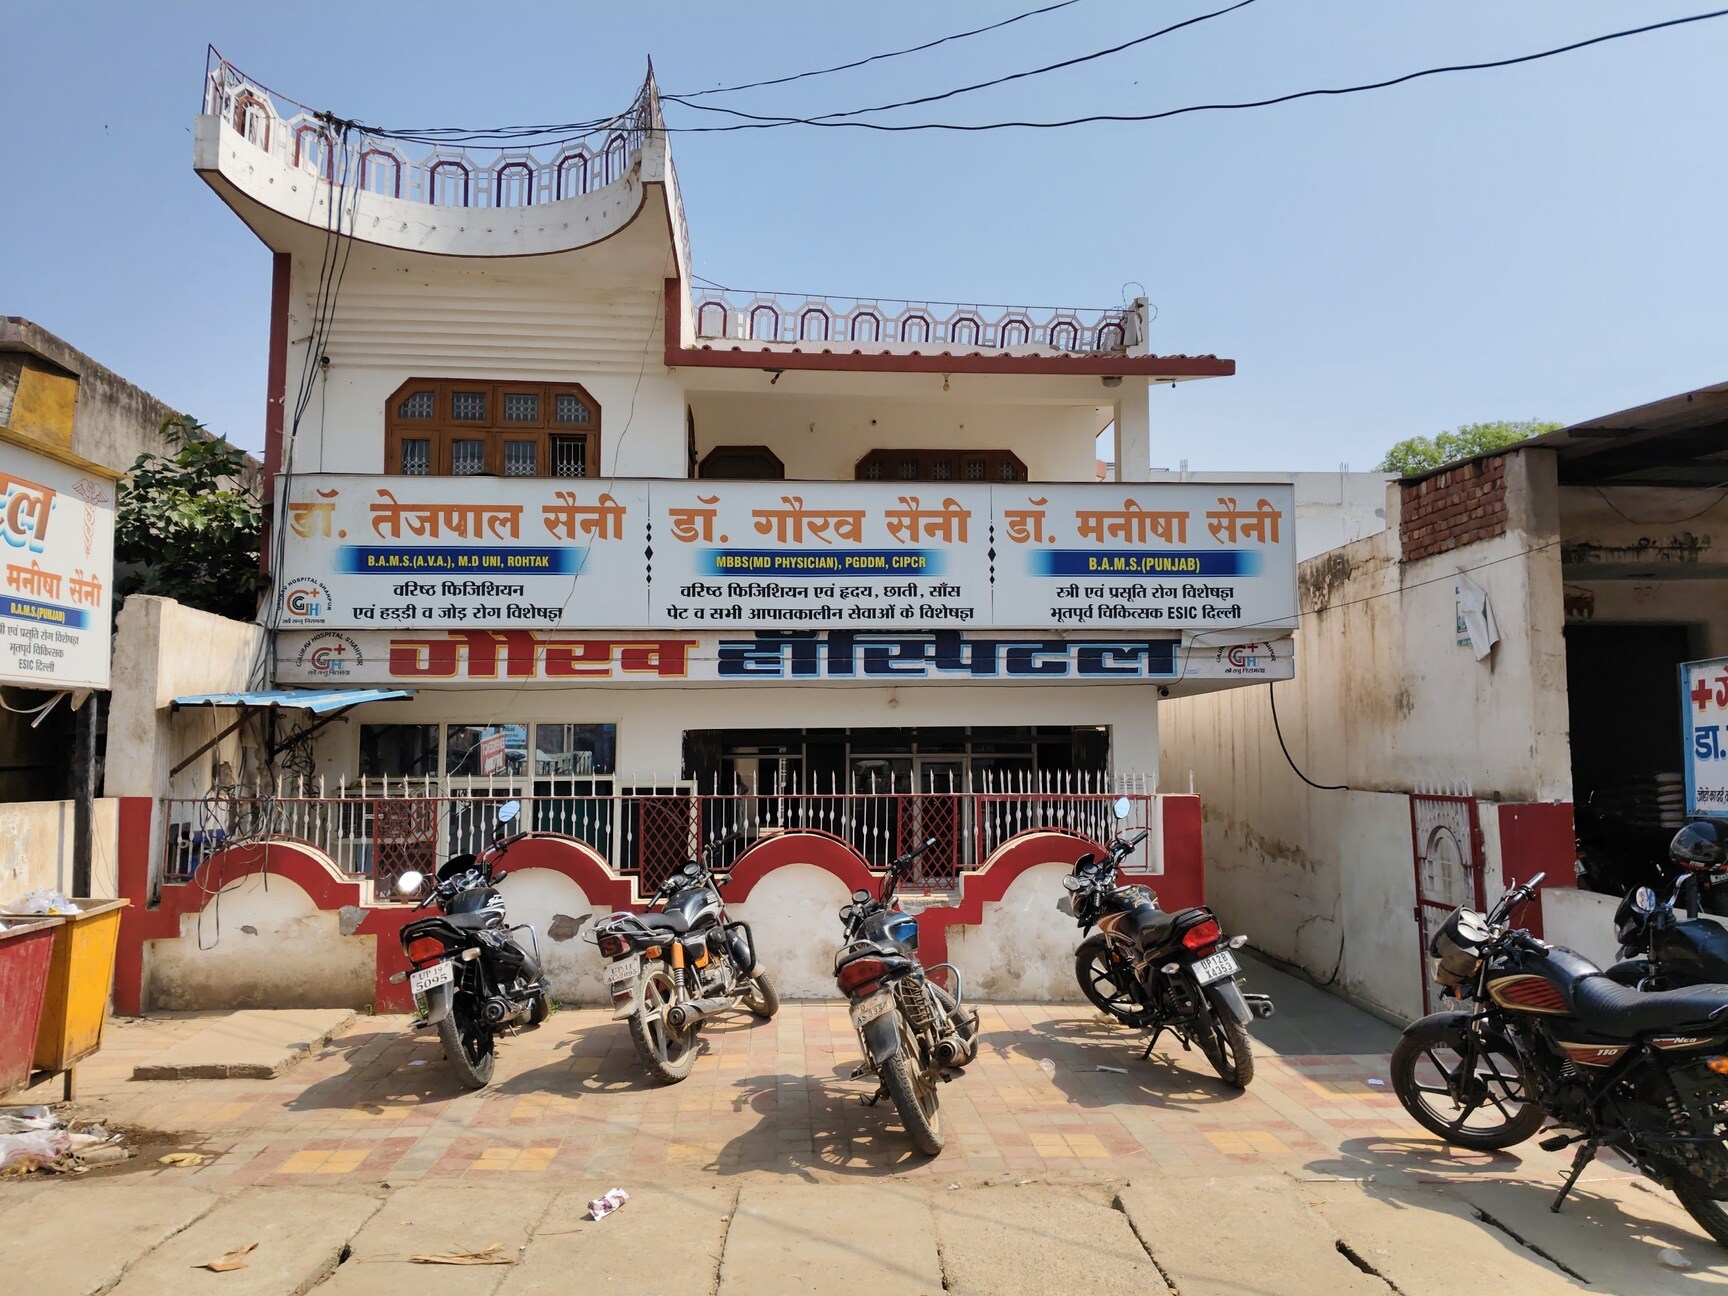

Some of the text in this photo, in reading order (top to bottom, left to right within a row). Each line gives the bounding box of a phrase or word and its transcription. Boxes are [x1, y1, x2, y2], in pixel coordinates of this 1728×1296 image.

[369, 488, 524, 540] तेजपाल
[541, 491, 627, 541] सैनी
[668, 494, 972, 544] डॉ. गौरव सैनी
[1004, 496, 1282, 545] डॉ. मनीषा सैनी
[367, 555, 549, 569] B.A.M.S.(A.V.A.), M.D UNI, ROHTAK
[716, 556, 927, 570] MBBS(MD PHYSICIAN), PGDDM, CIPCR
[1088, 557, 1200, 573] B.A.M.S.(PUNJAB)
[6, 559, 102, 607] मनीषा सैनी
[393, 581, 525, 597] वरिष्ठ फिजिशियन
[680, 582, 723, 598] वरिष्ठ
[727, 582, 809, 598] फिजिशियन
[813, 583, 836, 598] एवं
[1056, 583, 1234, 602] स्त्री एवं प्रसूति रोग विशेषज्ञ
[352, 604, 376, 619] एवं
[421, 606, 434, 619] व
[472, 603, 501, 619] रोग
[506, 603, 564, 622] विशेषज्ञ
[666, 604, 975, 621] पेट व सभी आपातकालीन सेवाओं के विशेषज्ञ
[1049, 604, 1242, 623] भूतपूर्व चिकित्सक ESIC दिल्ली
[311, 631, 344, 643] HOSPITAL
[19, 658, 34, 670] ESIC
[1694, 725, 1727, 759] डा.
[416, 973, 448, 991] 5095
[418, 970, 431, 980] UP
